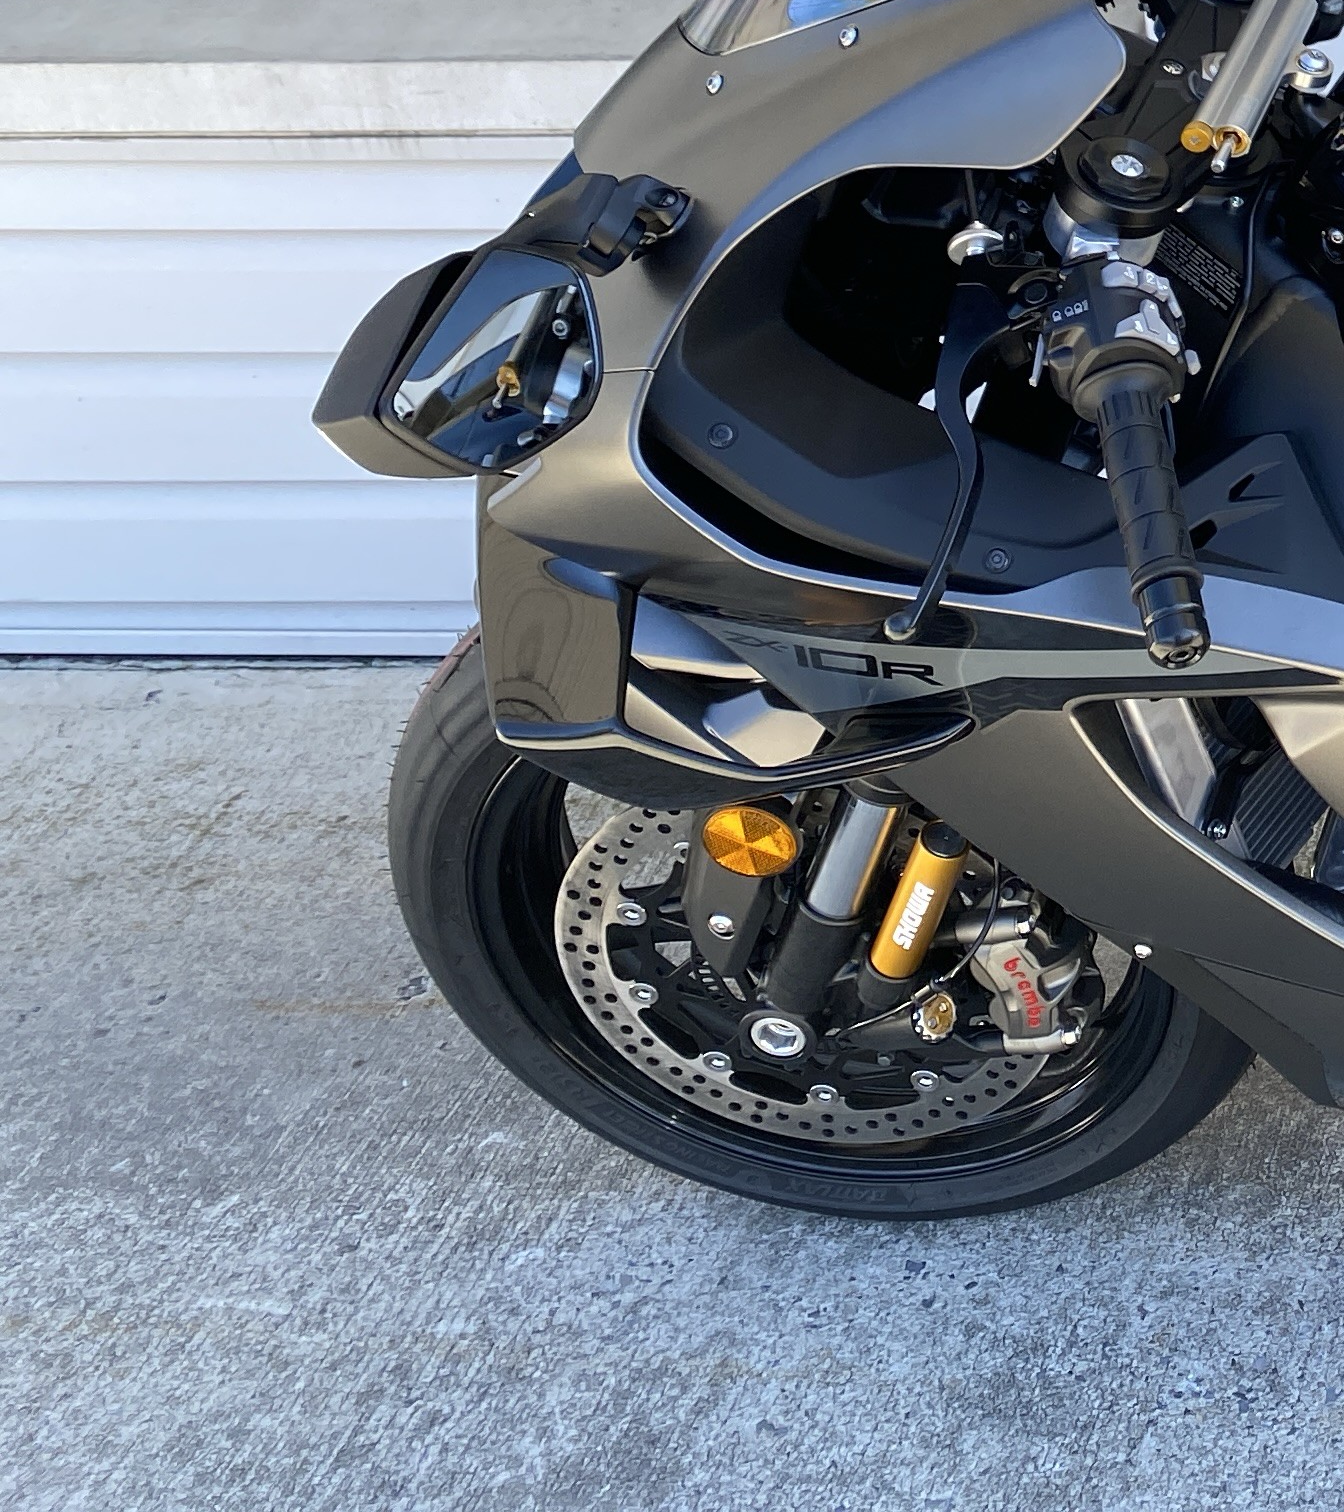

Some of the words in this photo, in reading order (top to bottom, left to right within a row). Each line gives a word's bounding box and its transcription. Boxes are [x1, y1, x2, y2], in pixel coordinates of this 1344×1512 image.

[723, 630, 943, 687] ZX-10R
[892, 881, 935, 951] SHOWA
[1003, 955, 1046, 1029] brembo
